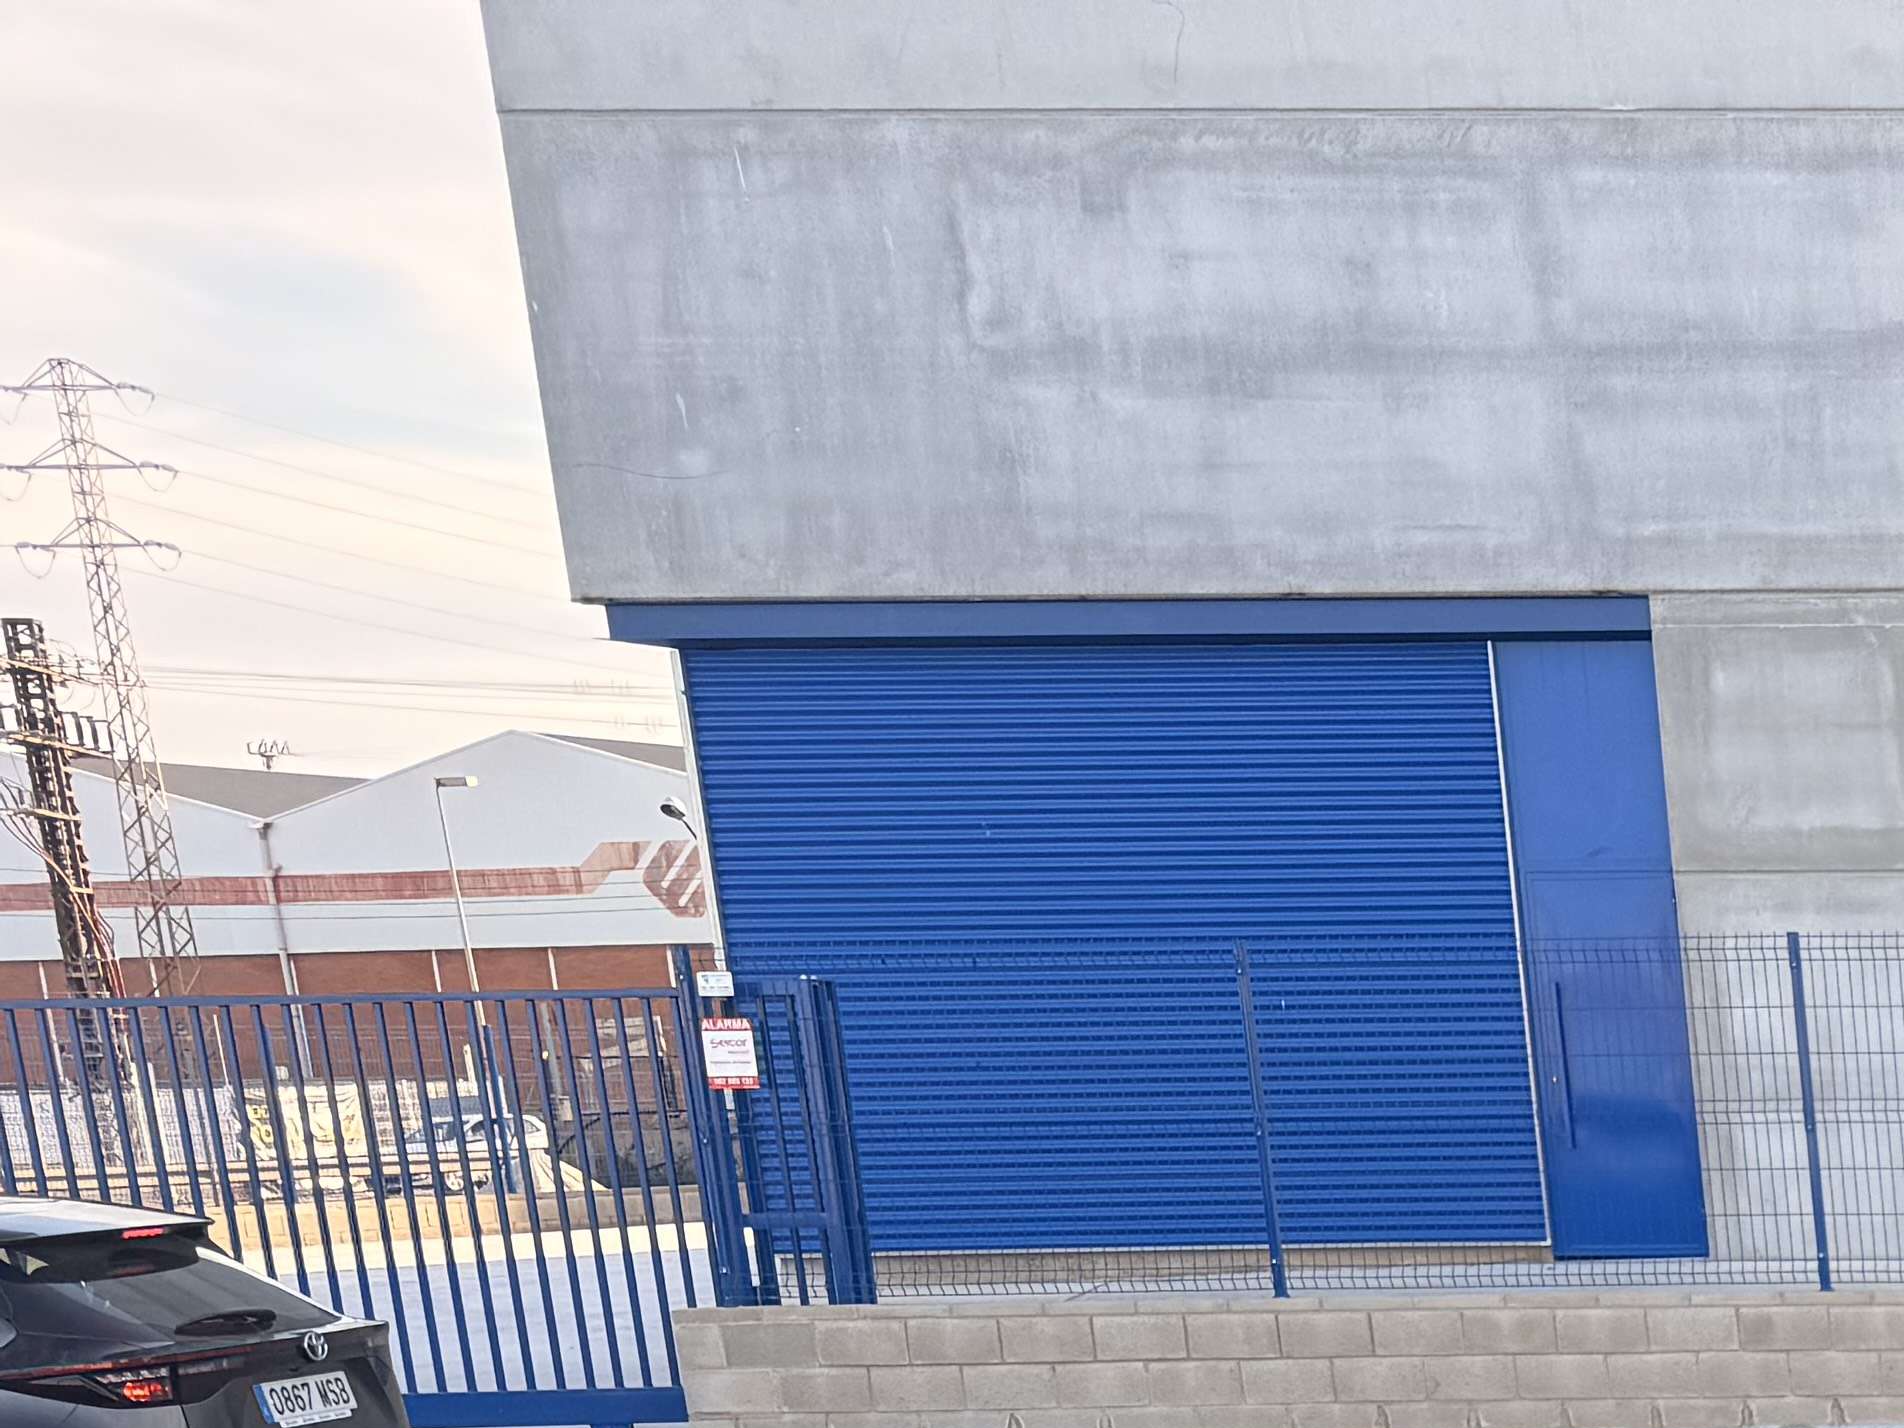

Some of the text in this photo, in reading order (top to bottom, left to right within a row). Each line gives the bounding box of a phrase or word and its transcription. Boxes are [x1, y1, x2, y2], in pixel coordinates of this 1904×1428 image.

[701, 1018, 751, 1030] ALARMA
[269, 1377, 350, 1415] 0867 MSB
